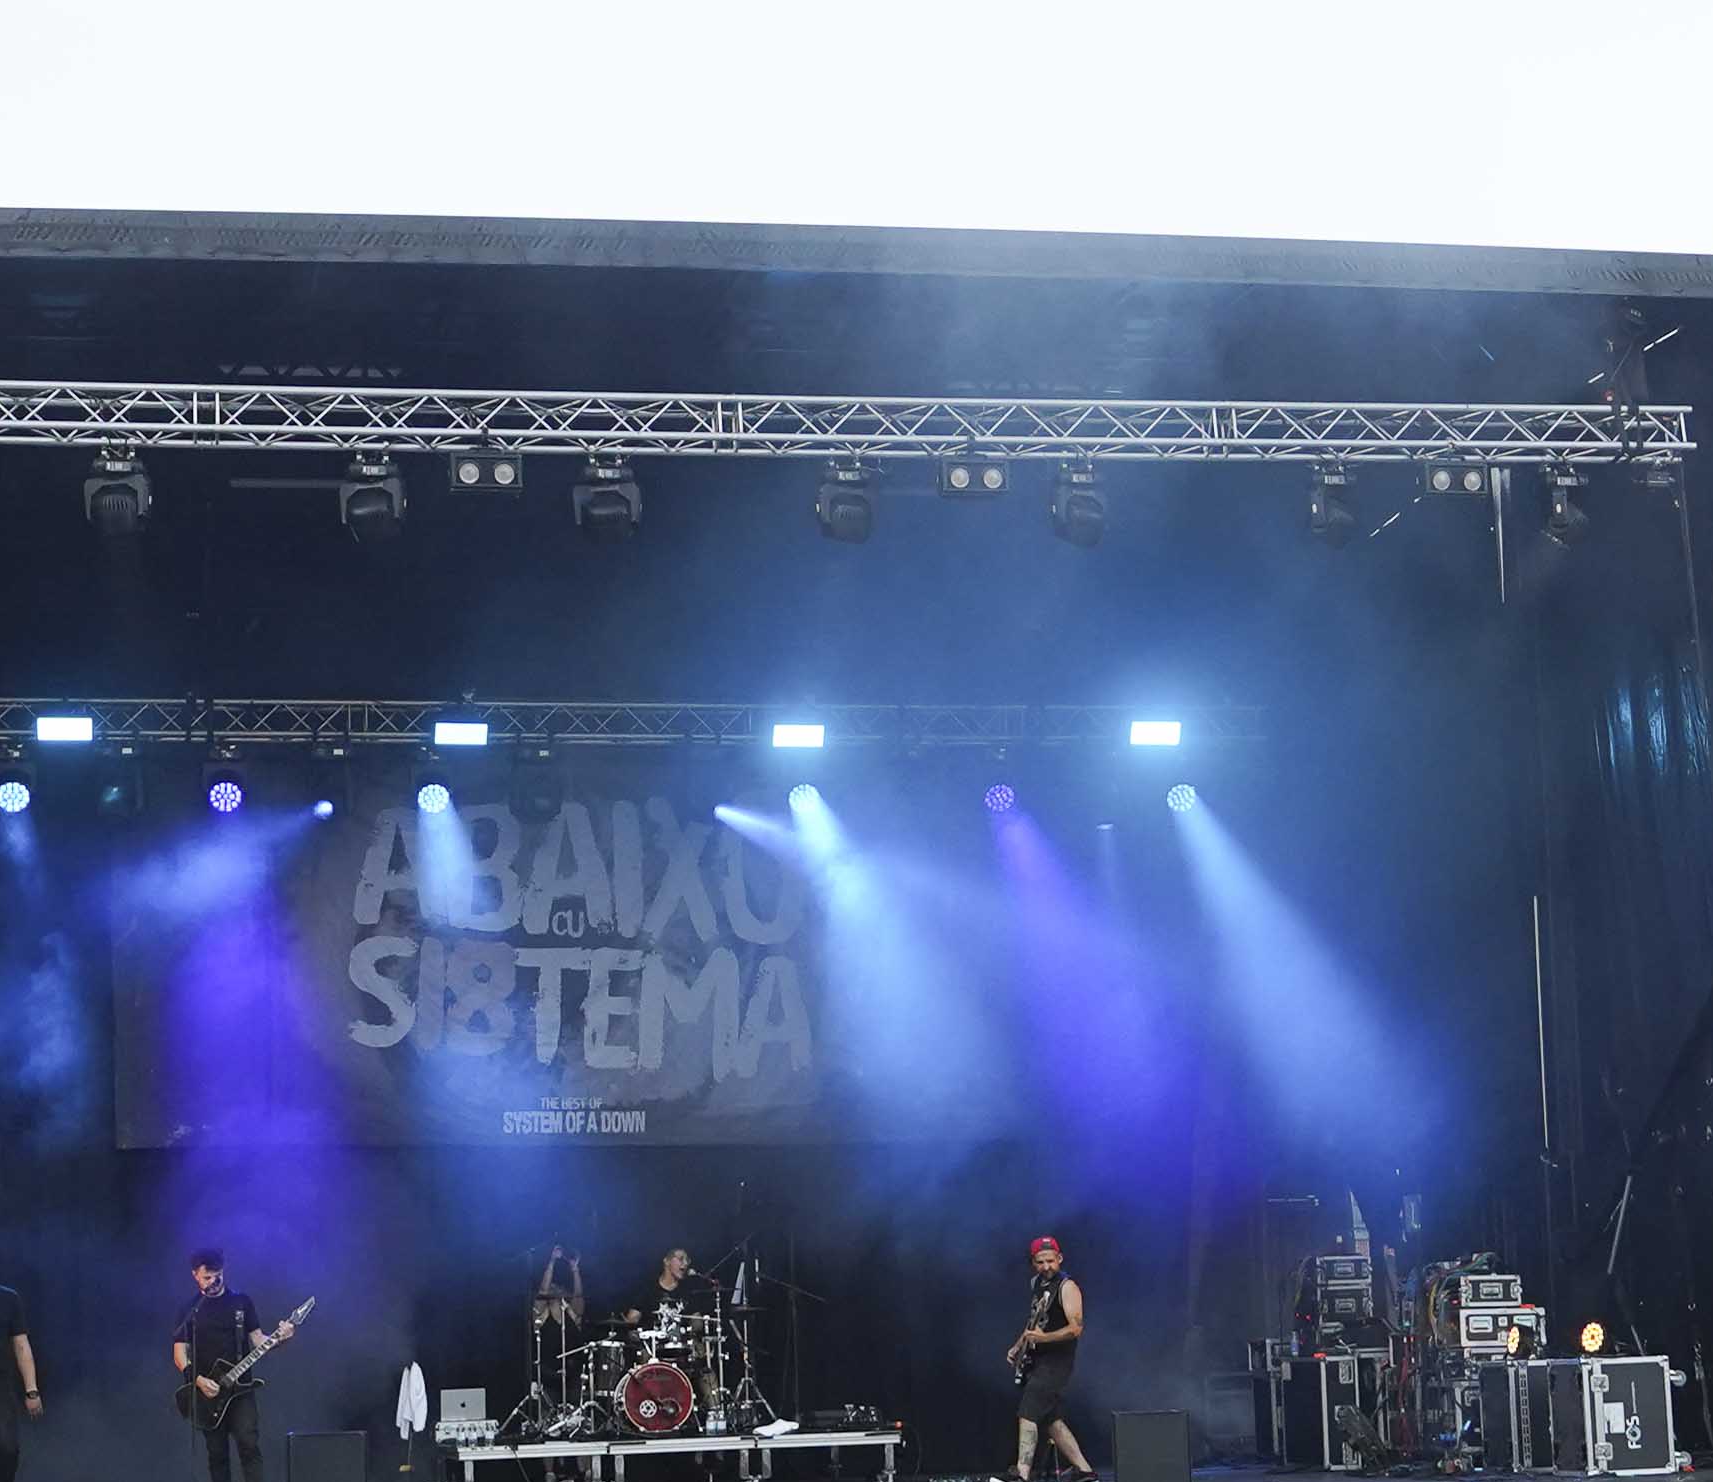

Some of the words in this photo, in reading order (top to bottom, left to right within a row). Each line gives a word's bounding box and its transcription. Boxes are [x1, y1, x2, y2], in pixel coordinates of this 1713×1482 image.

[540, 1097, 558, 1109] THE
[561, 1097, 586, 1109] BEST
[588, 1097, 603, 1108] OF
[503, 1112, 563, 1135] SYSTEM
[565, 1112, 585, 1134] OF
[587, 1112, 599, 1133] A
[601, 1111, 646, 1133] DOWN
